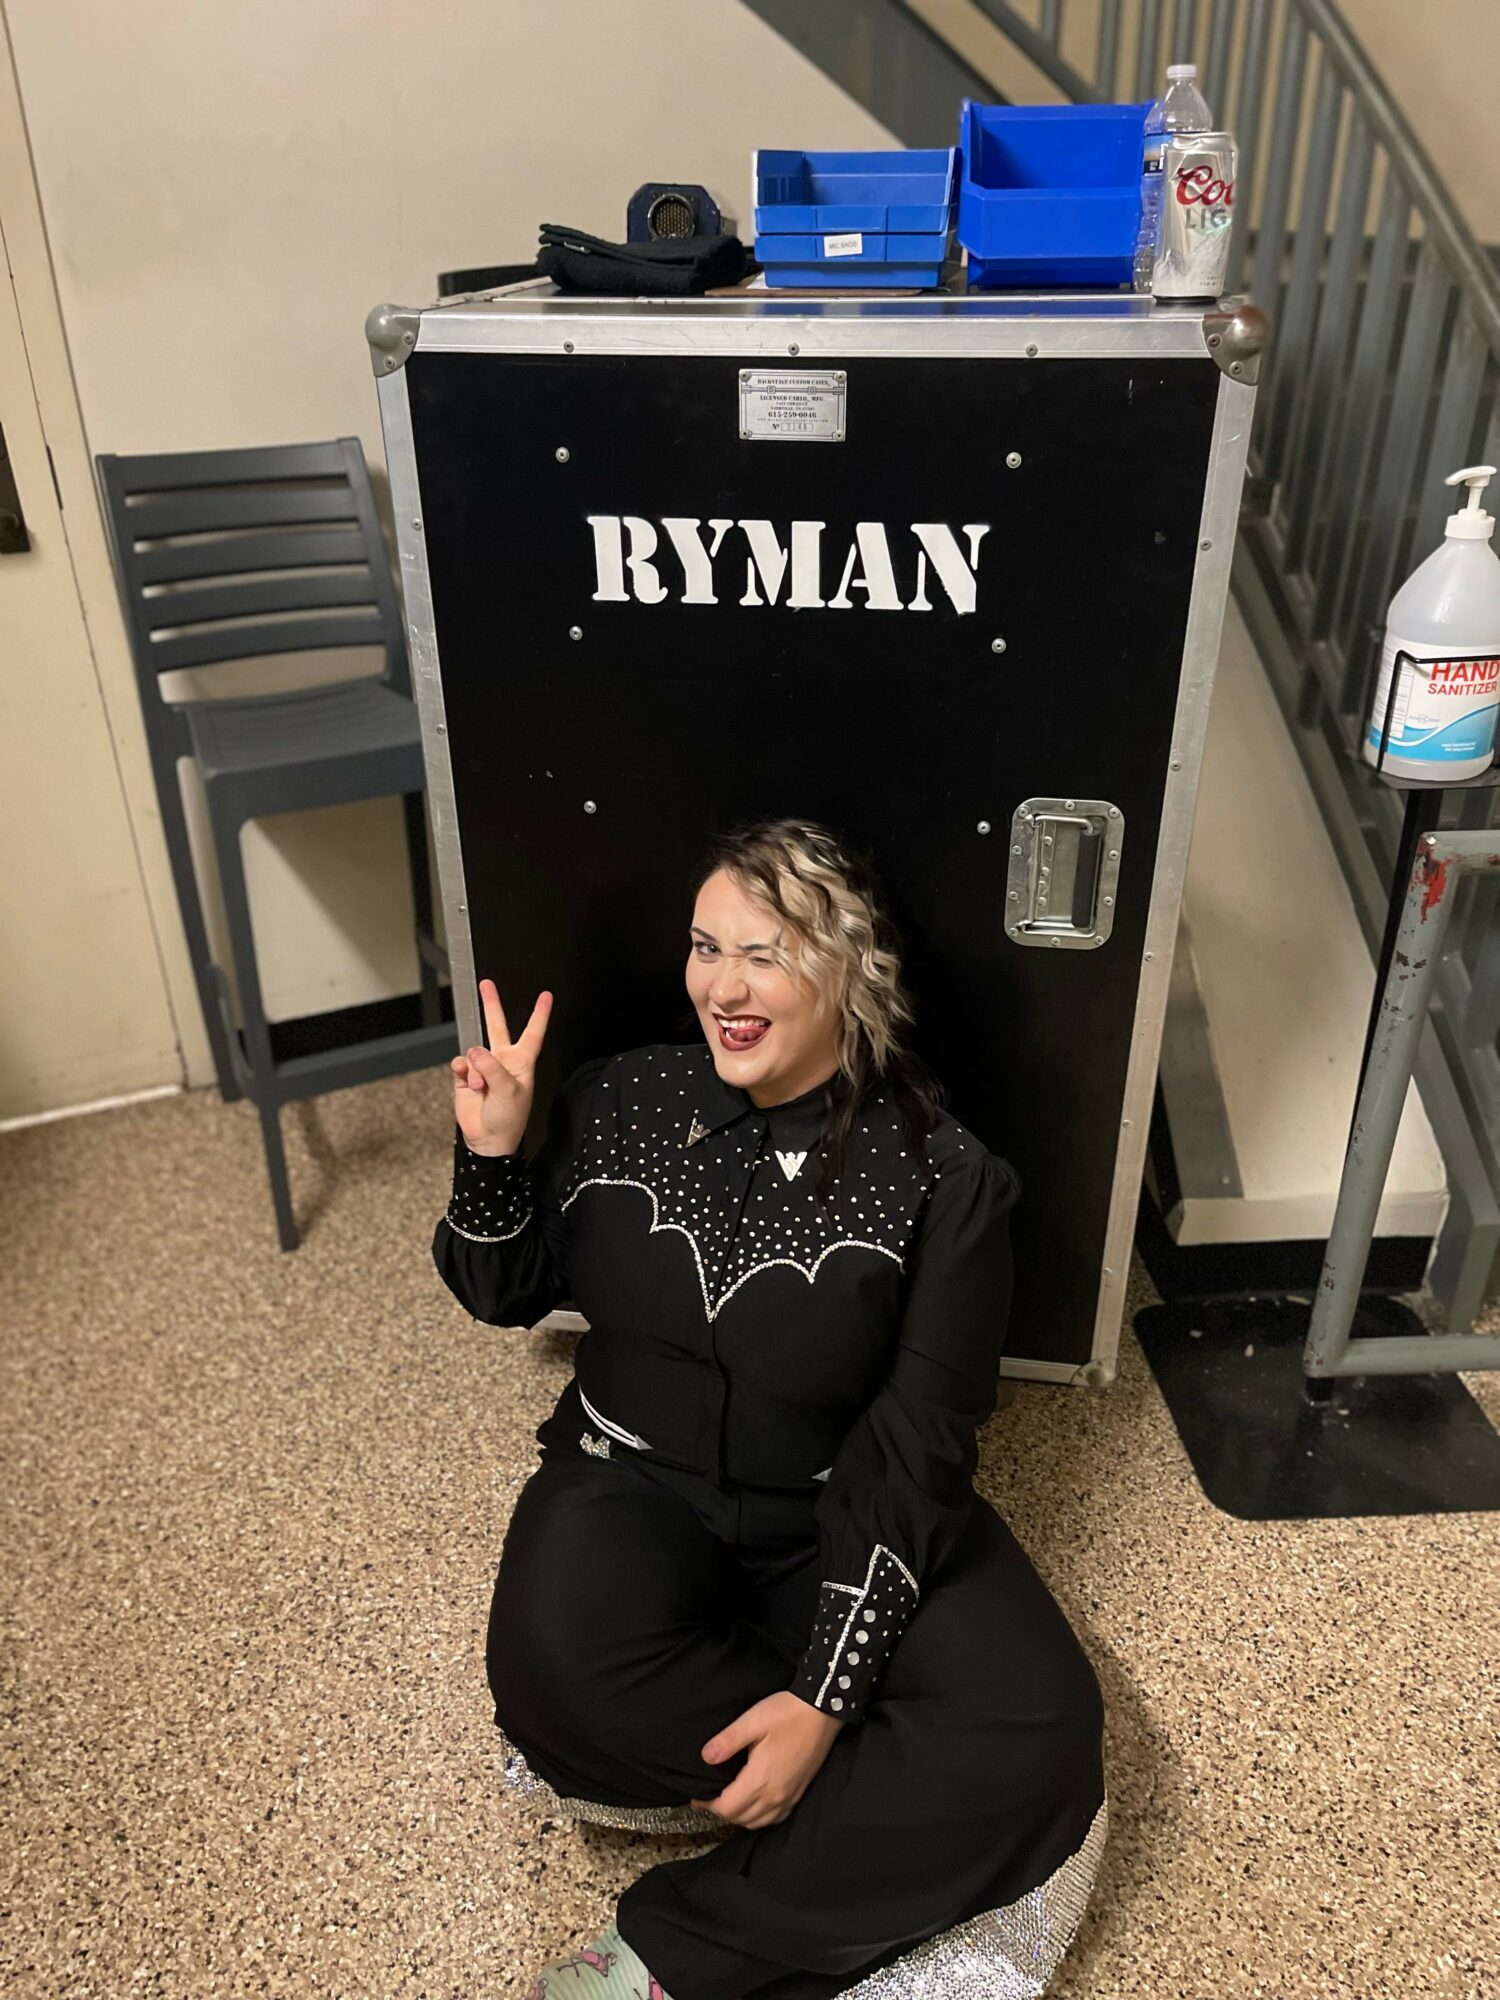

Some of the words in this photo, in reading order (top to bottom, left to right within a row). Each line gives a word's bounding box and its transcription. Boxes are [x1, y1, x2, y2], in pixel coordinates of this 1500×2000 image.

[841, 241, 857, 249] BAGS
[587, 516, 990, 614] RYMAN
[1431, 660, 1500, 682] HAND
[1427, 681, 1498, 696] SANITIZER
